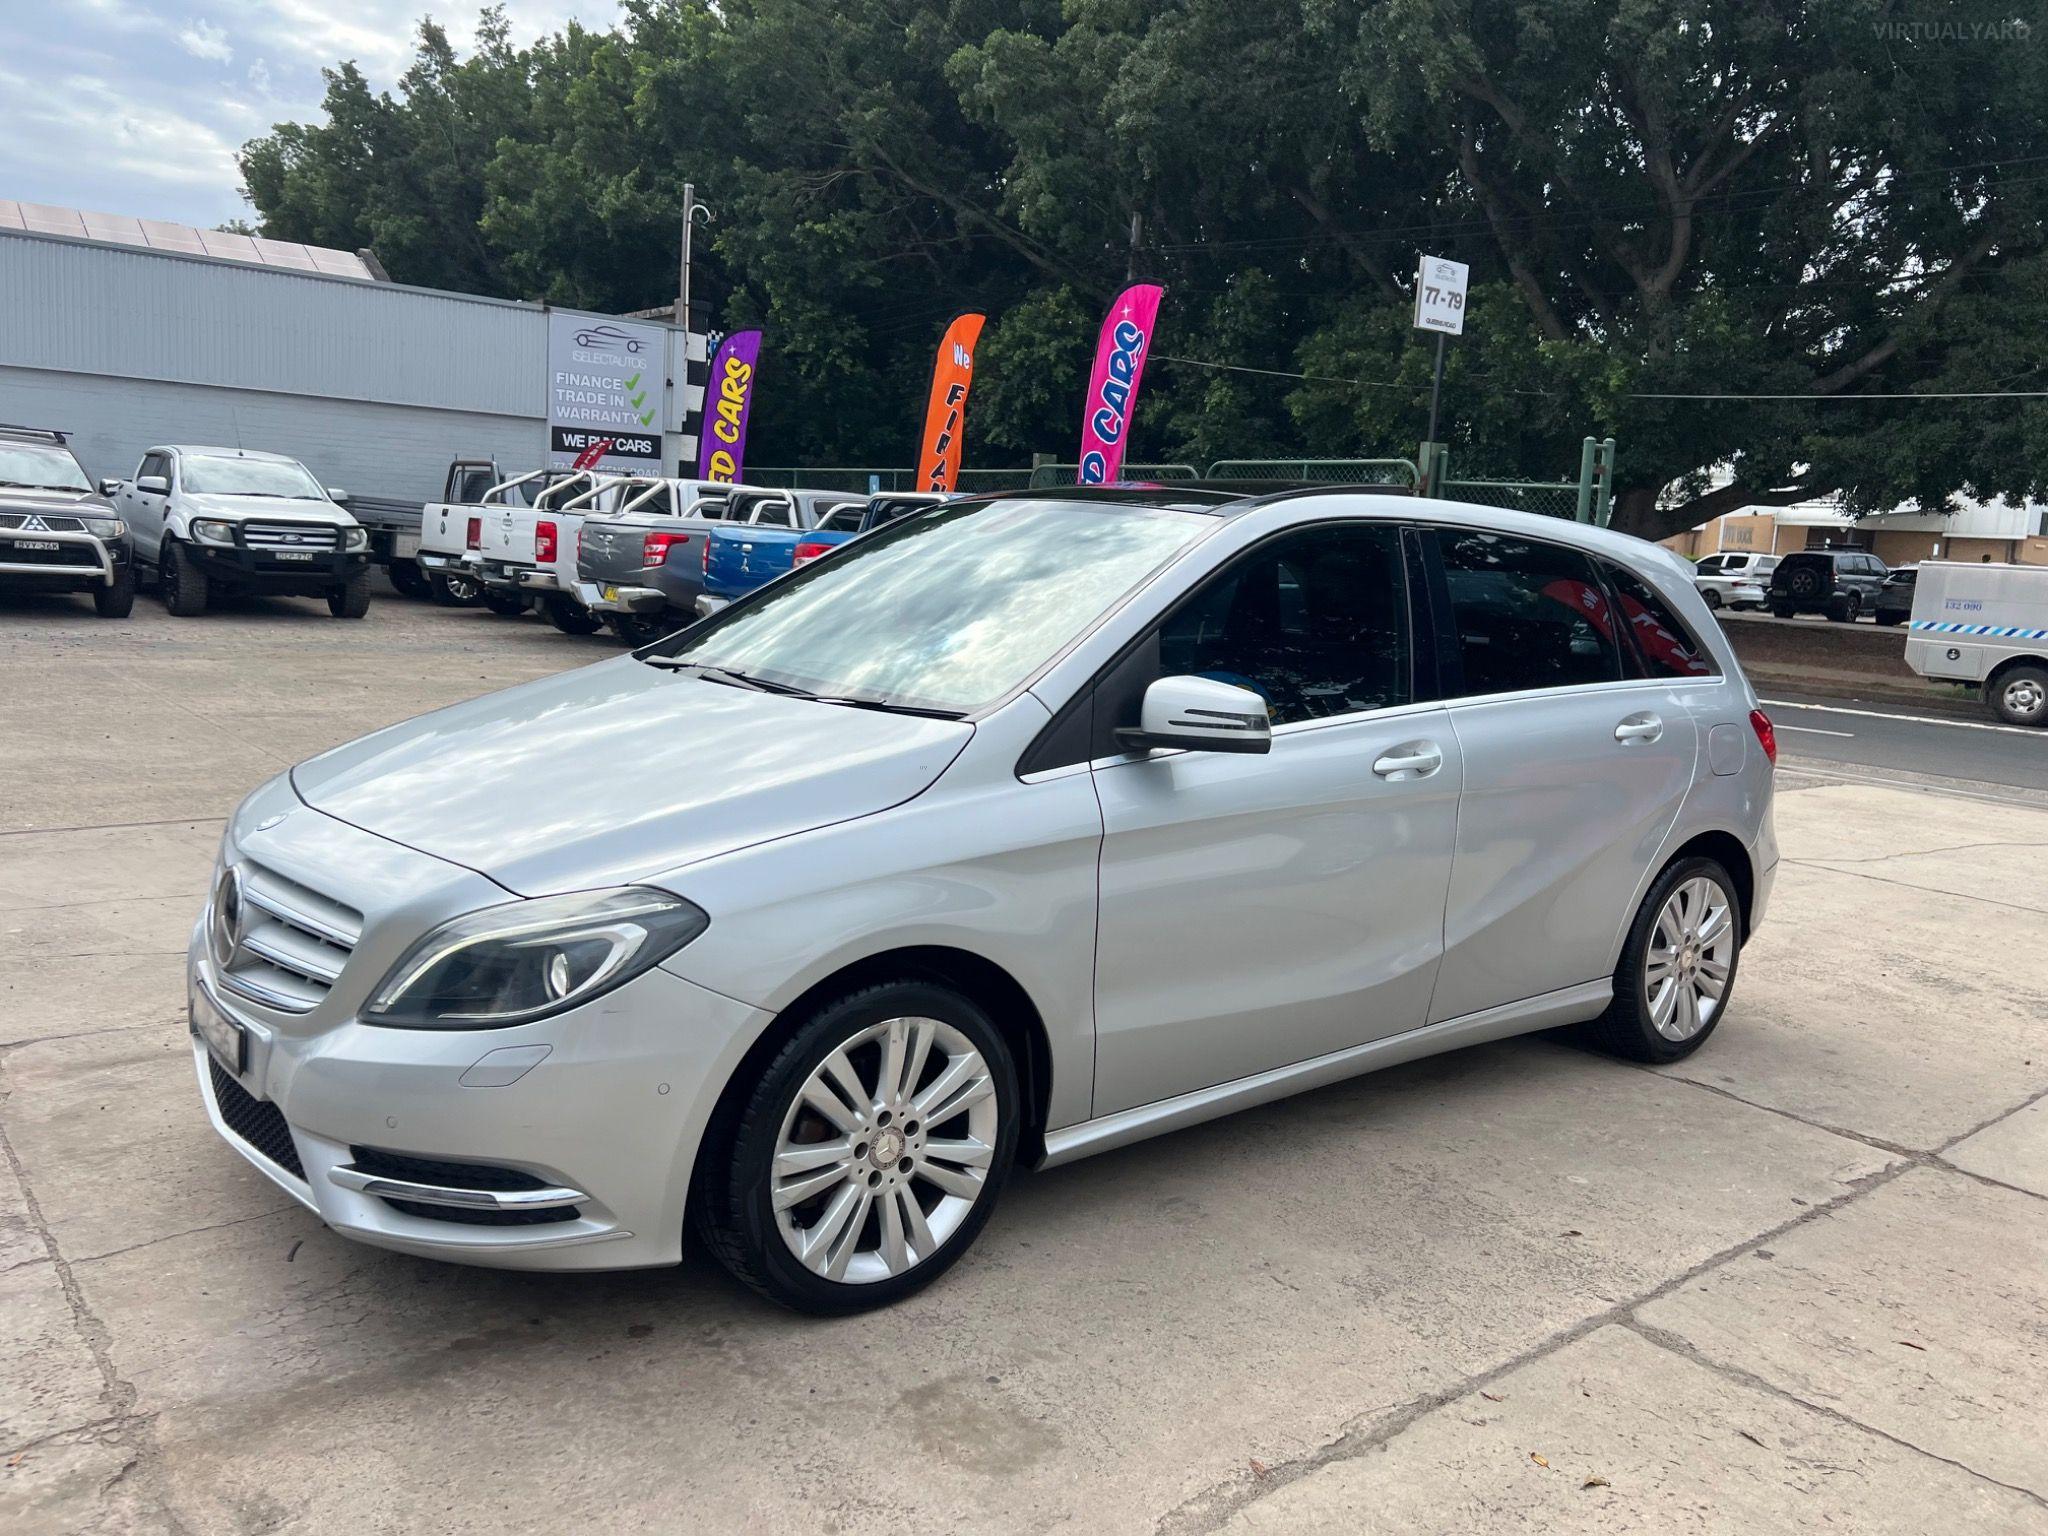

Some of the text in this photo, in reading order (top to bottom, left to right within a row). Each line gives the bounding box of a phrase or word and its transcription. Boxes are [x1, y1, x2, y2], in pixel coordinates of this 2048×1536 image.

[953, 341, 970, 370] We
[556, 372, 622, 391] FINANCE
[1092, 320, 1144, 445] CARS
[556, 389, 625, 407] TRADE IN
[713, 356, 752, 445] CARS
[556, 406, 641, 425] WARRANTY
[562, 433, 586, 448] WE
[615, 438, 652, 453] CARS
